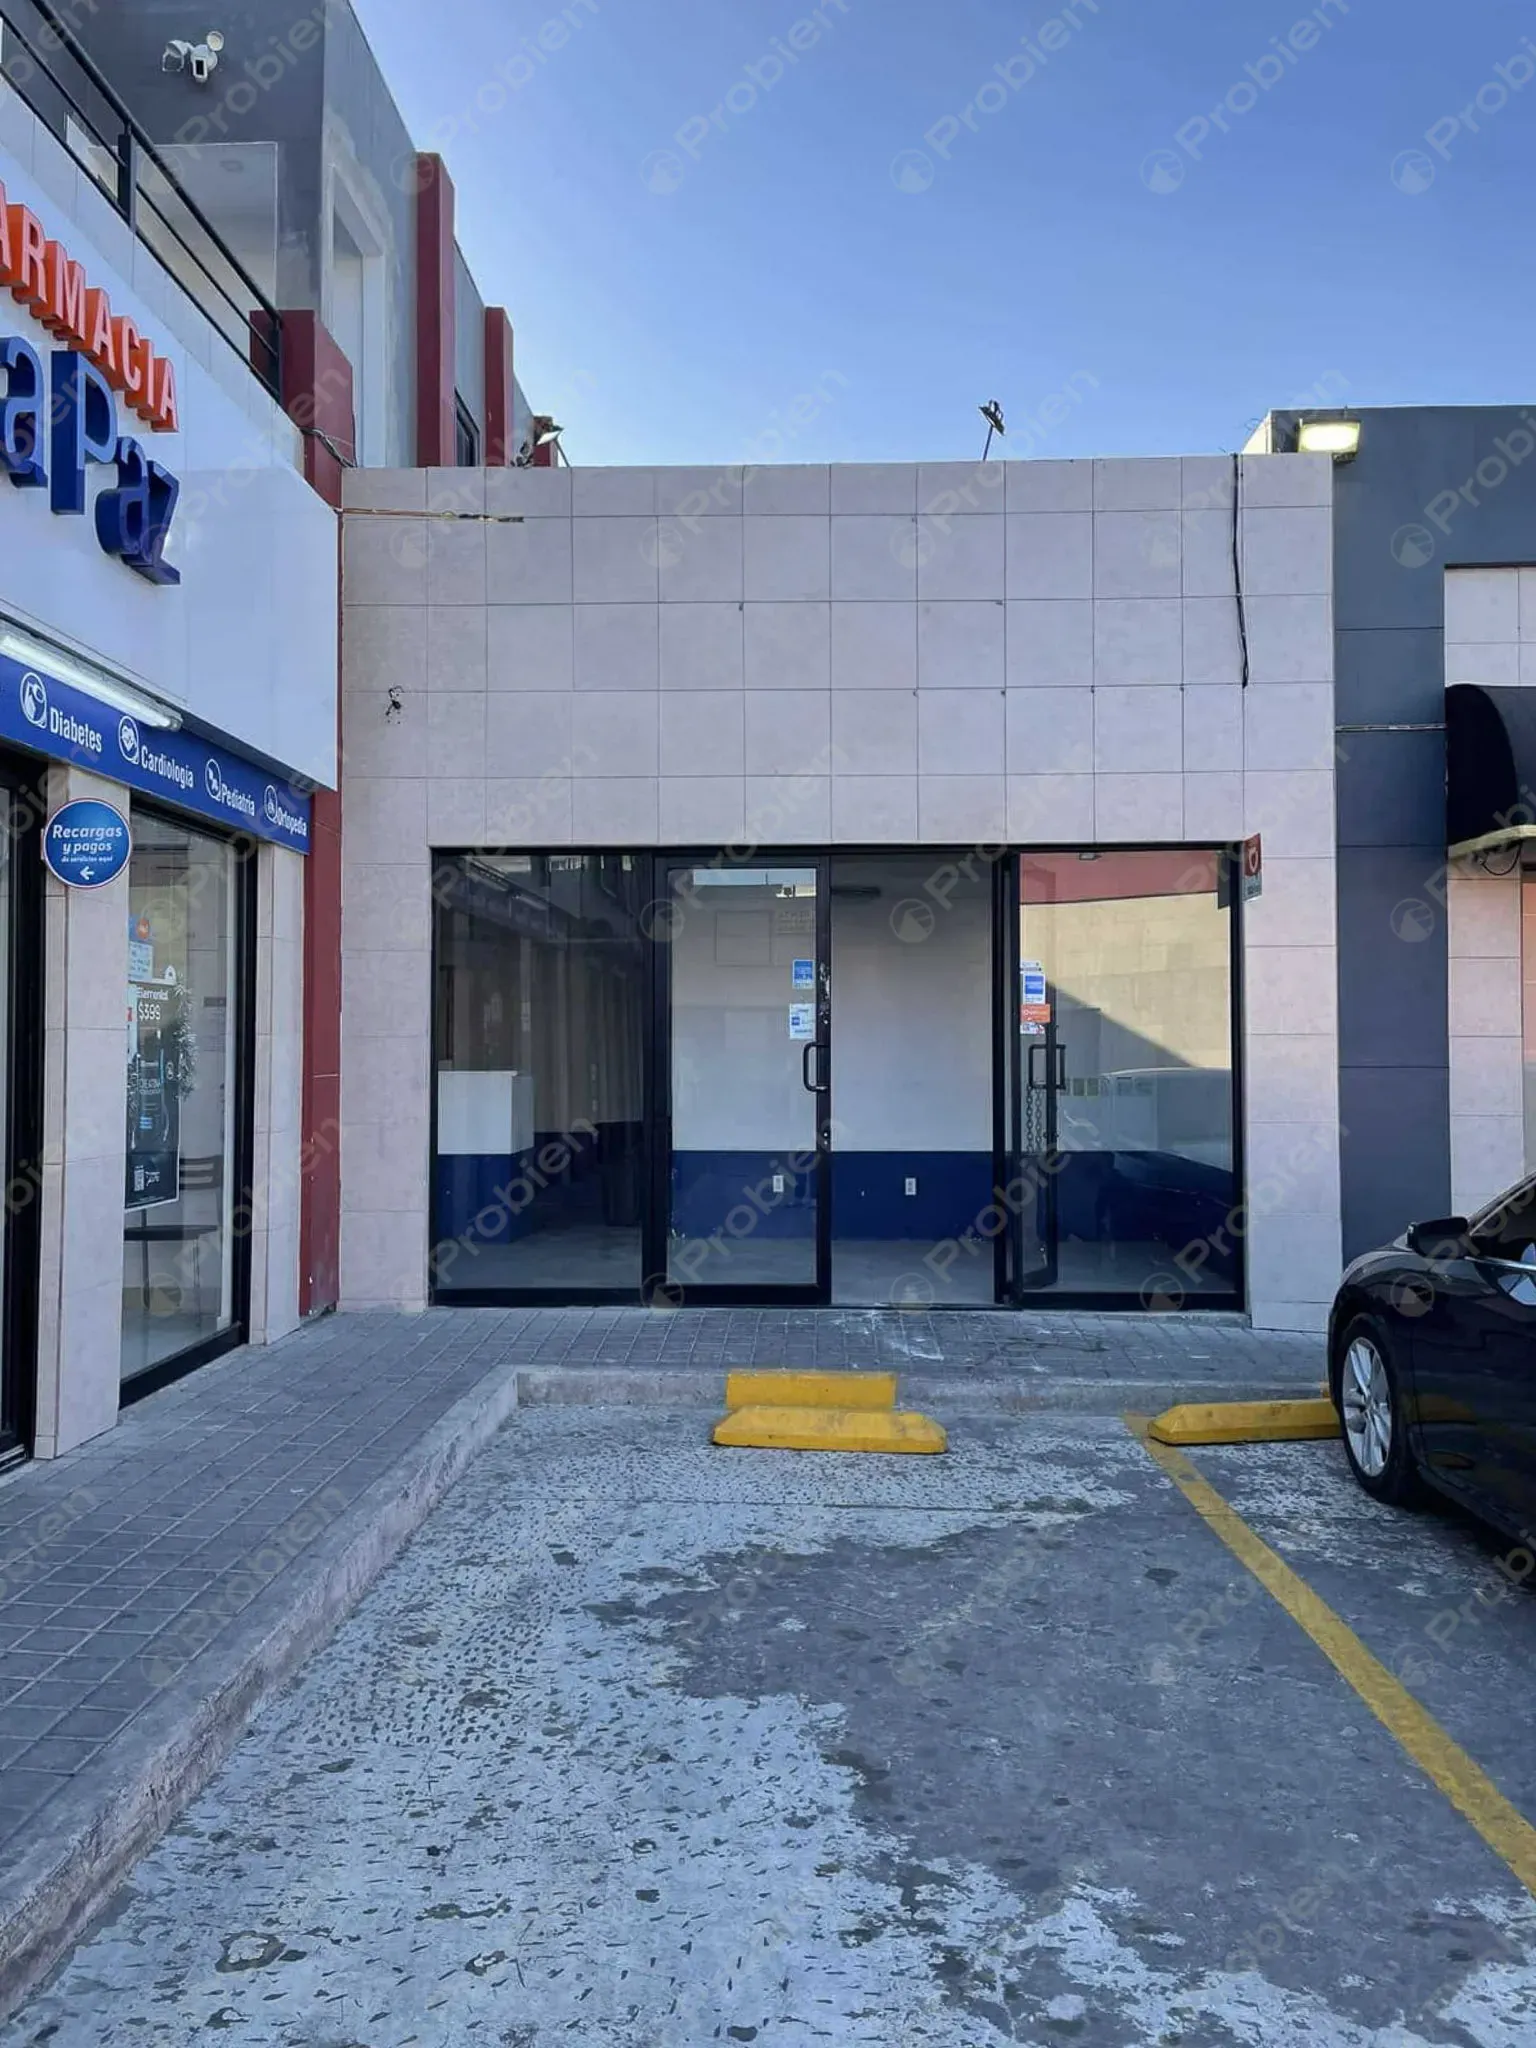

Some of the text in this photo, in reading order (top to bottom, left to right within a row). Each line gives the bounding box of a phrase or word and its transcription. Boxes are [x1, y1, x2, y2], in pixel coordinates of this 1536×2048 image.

[50, 706, 102, 753] Diabetes
[52, 824, 122, 841] Recargas
[62, 842, 112, 854] y pagos
